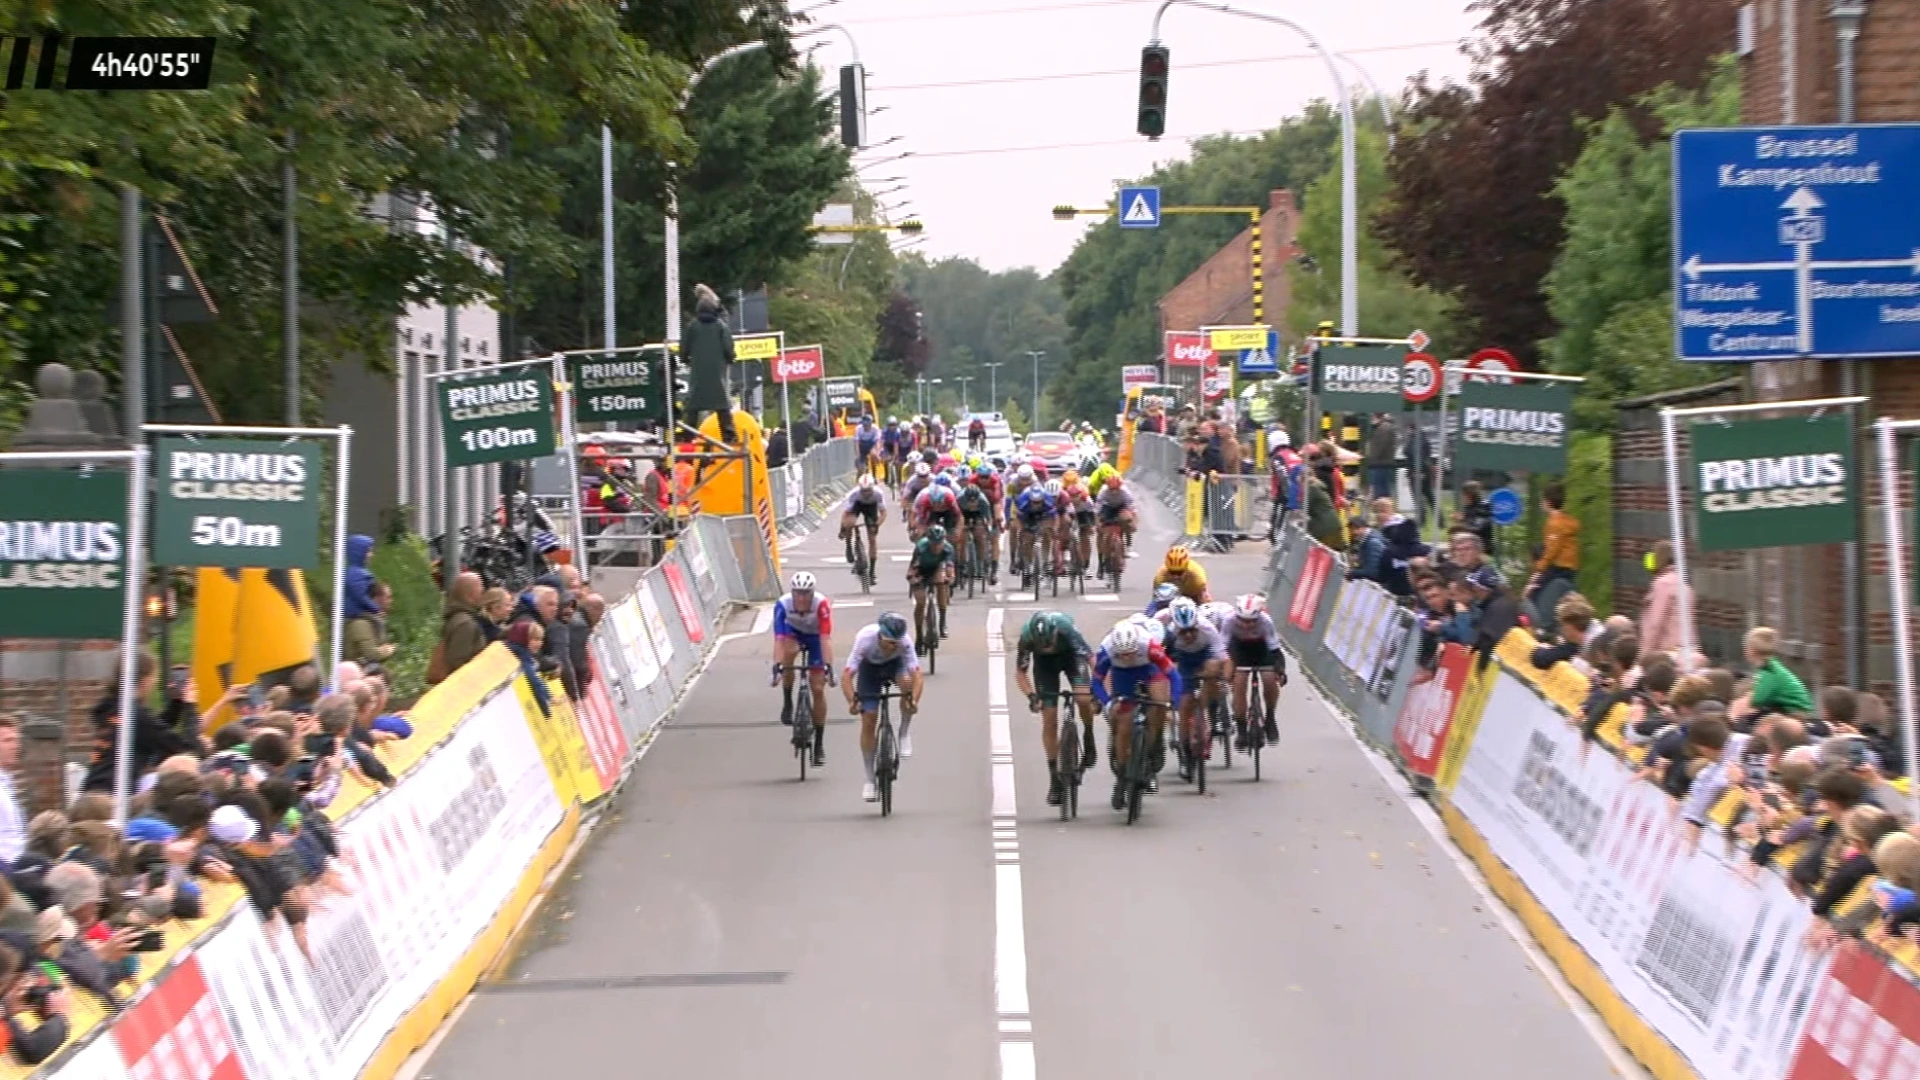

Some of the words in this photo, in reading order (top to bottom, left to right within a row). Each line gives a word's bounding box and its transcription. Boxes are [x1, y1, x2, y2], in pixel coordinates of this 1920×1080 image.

[1755, 133, 1859, 160] Brussel
[1718, 161, 1883, 191] Kampenhout
[1684, 282, 1761, 301] Tildonk
[1173, 343, 1212, 360] lotto
[1709, 333, 1800, 352] Centrum
[581, 361, 650, 380] PRIMUS
[1324, 364, 1401, 383] PRIMUS
[1402, 368, 1431, 387] 50
[582, 376, 651, 390] CLASSIC
[1324, 382, 1401, 394] CLASSIC
[447, 379, 541, 409] PRIMUS
[588, 394, 647, 412] 150m
[451, 400, 541, 421] CLASSIC
[1463, 406, 1566, 433] PRIMUS
[460, 427, 538, 451] 100m
[1463, 429, 1563, 448] CLASSIC
[170, 452, 307, 482] PRIMUS
[1700, 453, 1847, 493] PRIMUS
[169, 481, 305, 501] CLASSIC
[1702, 485, 1847, 513] CLASSIC
[0, 521, 122, 561] RIMUS
[191, 516, 282, 547] 50m
[0, 563, 121, 589] LASSIC
